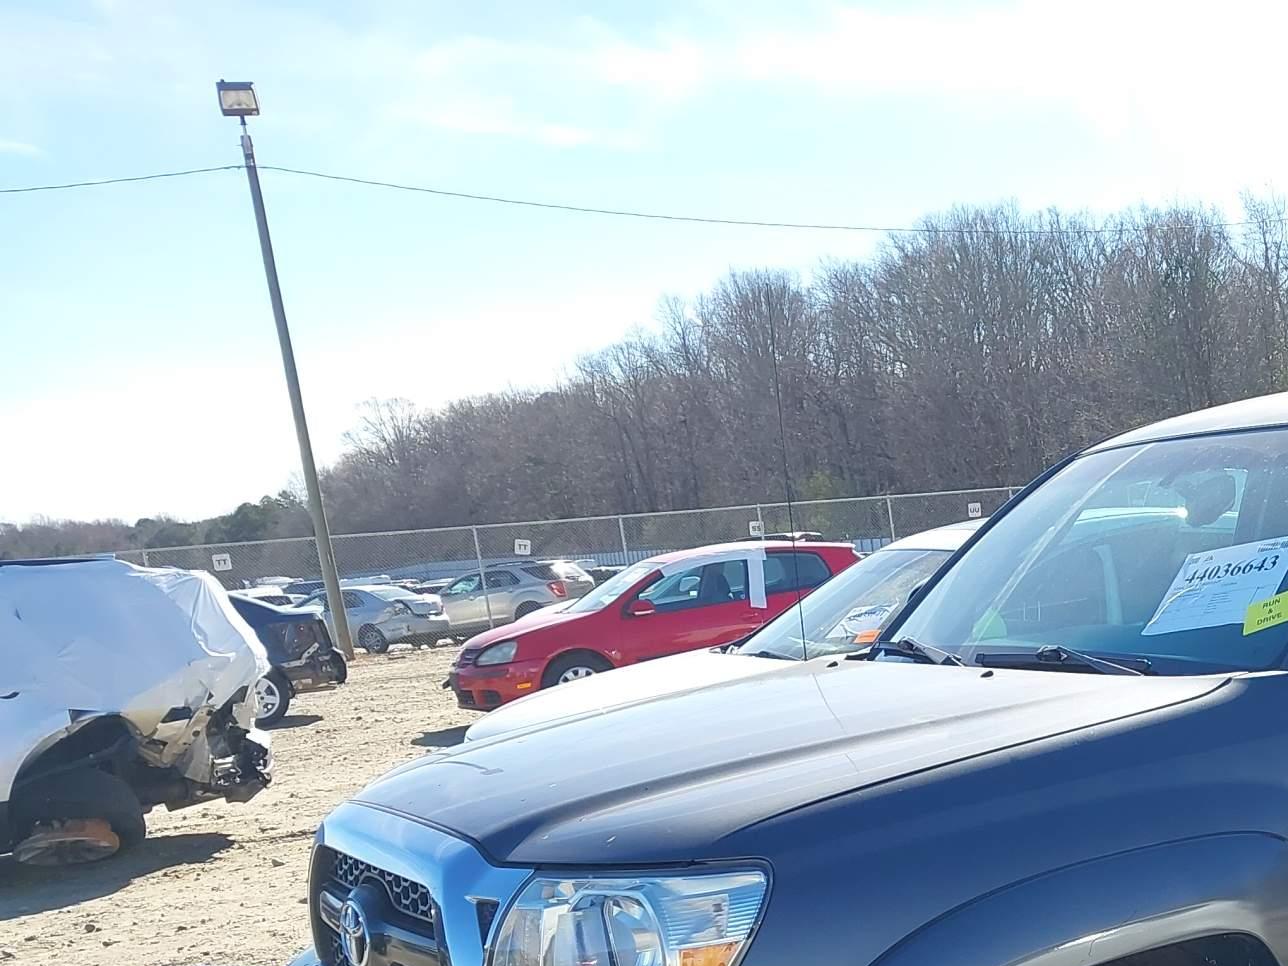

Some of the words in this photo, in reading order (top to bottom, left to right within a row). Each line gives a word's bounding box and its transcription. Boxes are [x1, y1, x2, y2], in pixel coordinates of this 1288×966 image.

[1184, 555, 1280, 584] 44036643
[1262, 597, 1281, 609] RUN
[1256, 612, 1283, 626] DRIVE
